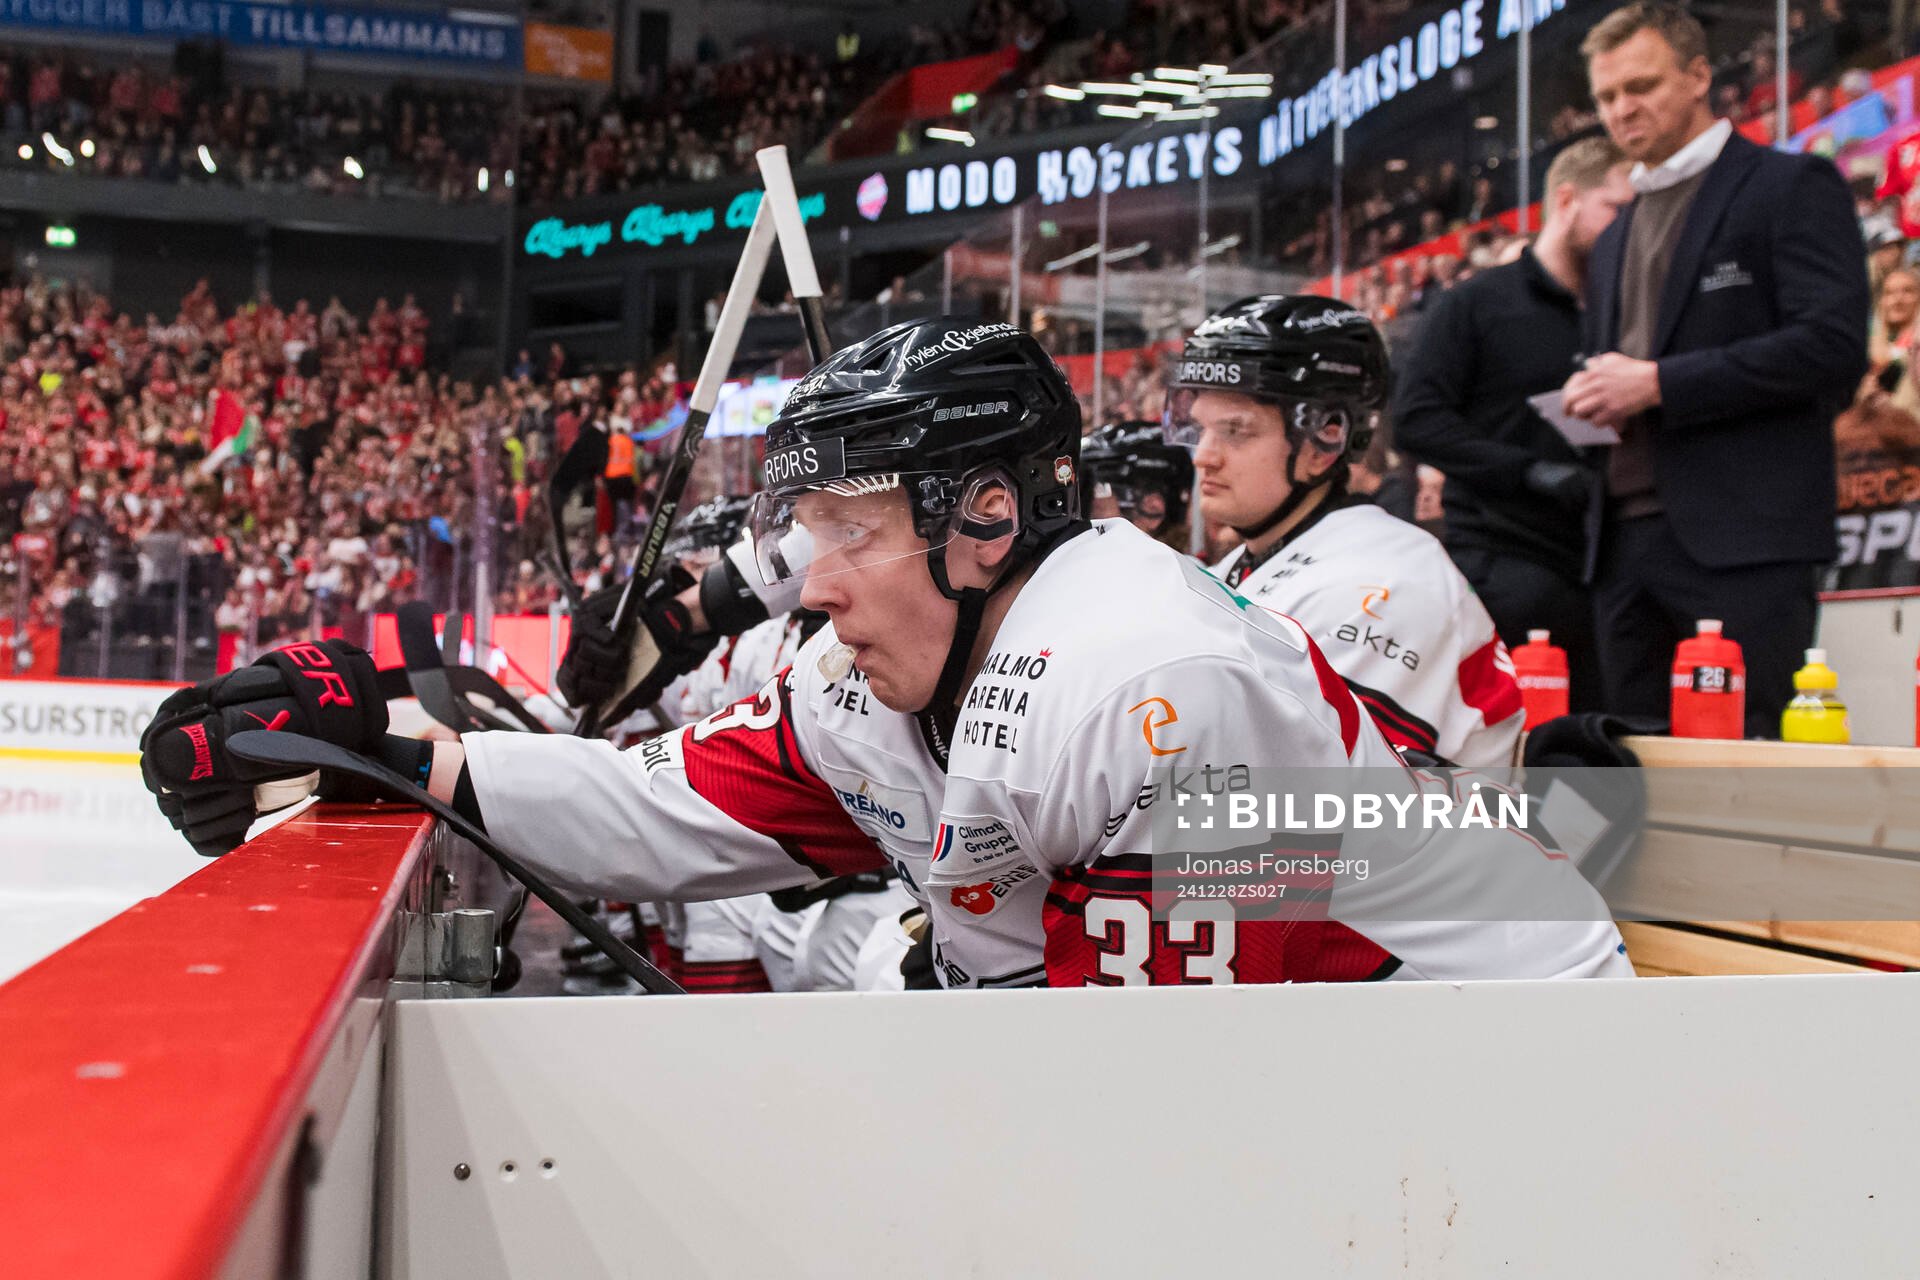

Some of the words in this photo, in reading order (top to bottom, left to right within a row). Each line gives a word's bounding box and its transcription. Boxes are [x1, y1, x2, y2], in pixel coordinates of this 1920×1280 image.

[248, 9, 506, 57] TILLSAMMANS
[906, 155, 1017, 215] MODO
[1037, 126, 1243, 206] HOCKEYS
[933, 401, 1009, 422] BAUER
[1336, 624, 1420, 671] akta
[967, 685, 1029, 717] ARENA
[963, 720, 1018, 755] HOTEL
[1084, 894, 1239, 987] 33
